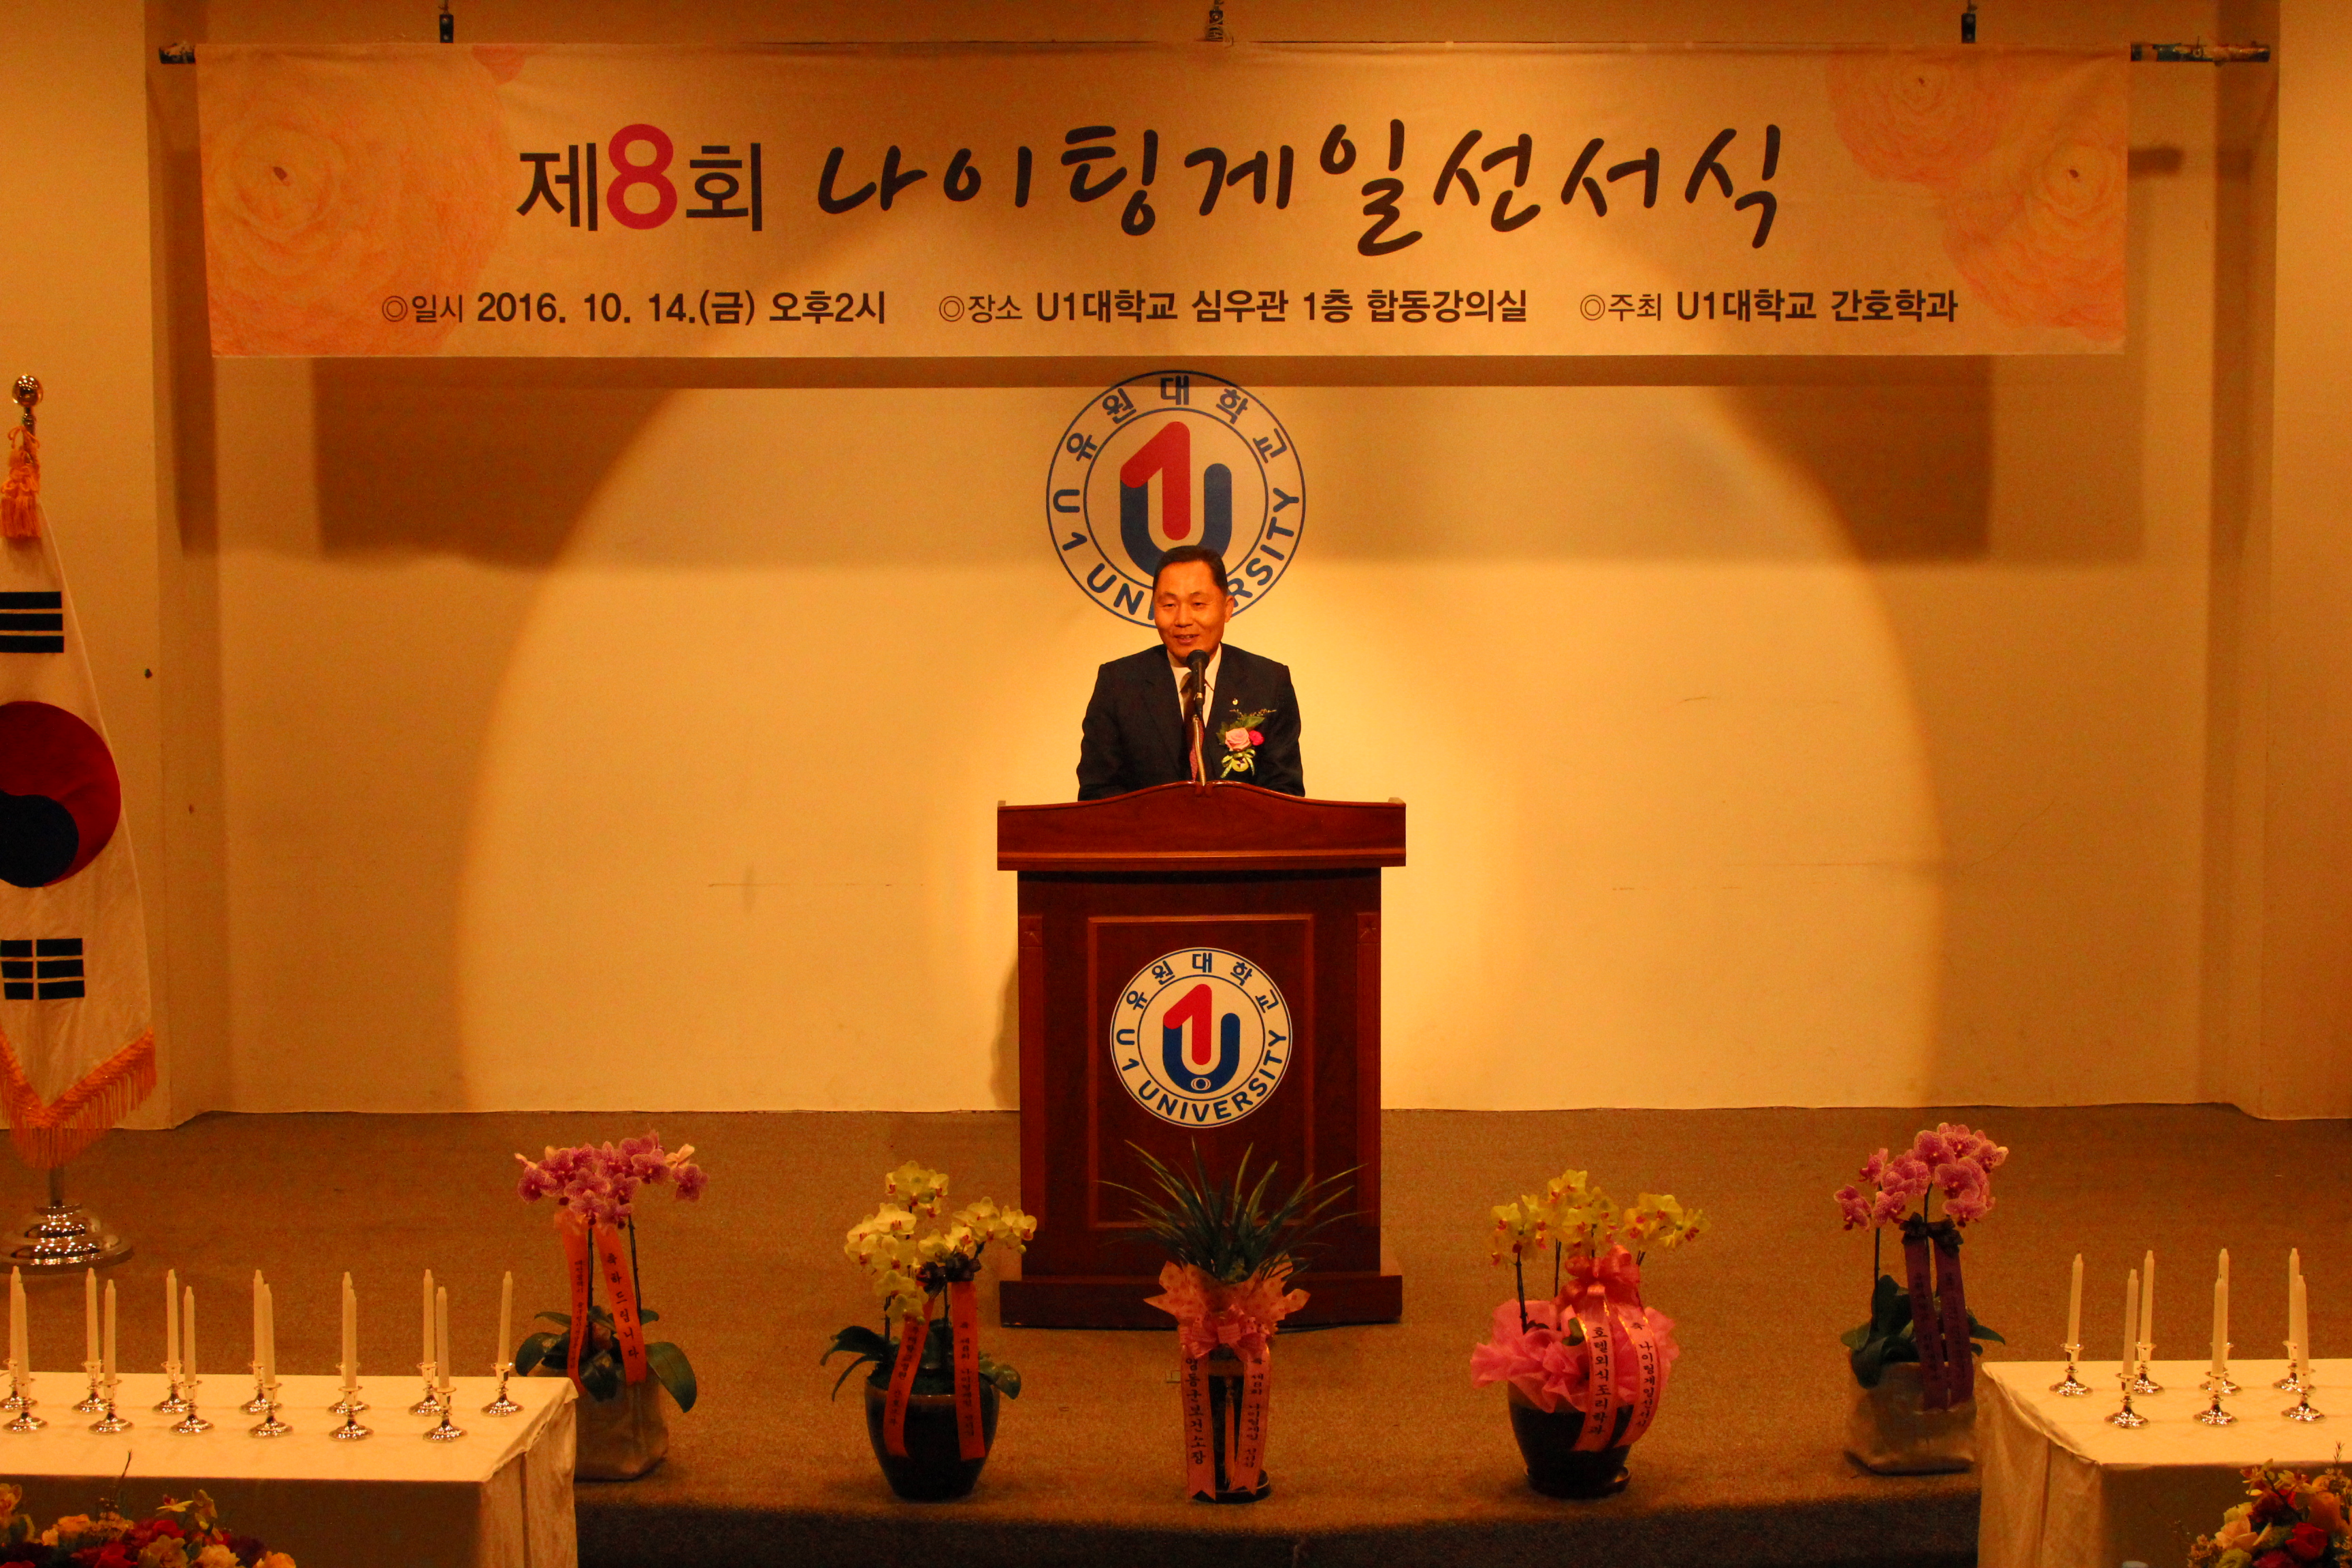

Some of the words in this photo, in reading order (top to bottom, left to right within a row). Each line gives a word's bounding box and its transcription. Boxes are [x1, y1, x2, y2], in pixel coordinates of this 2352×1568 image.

[516, 123, 763, 232] 제8회
[817, 118, 1782, 257] 나이팅게일선서식
[411, 294, 463, 324] 일시
[477, 291, 566, 324] 2016.
[583, 291, 631, 324] 10.
[648, 289, 755, 327] 14.(금)
[768, 289, 885, 325] 오후2시
[968, 294, 1023, 324] 장소
[1036, 289, 1179, 324] U1대학교
[1191, 289, 1290, 323] 심우관
[1303, 288, 1354, 324] 1층
[1367, 289, 1527, 324] 합동강의실
[1607, 293, 1662, 323] 주최
[1677, 288, 1818, 323] U1대학교
[1831, 288, 1959, 323] 간호학과
[1066, 374, 1288, 464] 유원대학교
[1087, 487, 1301, 621] UNIRSITY
[1126, 952, 1280, 1014] 유원대학교
[1138, 1029, 1288, 1122] UNIVERSITY
